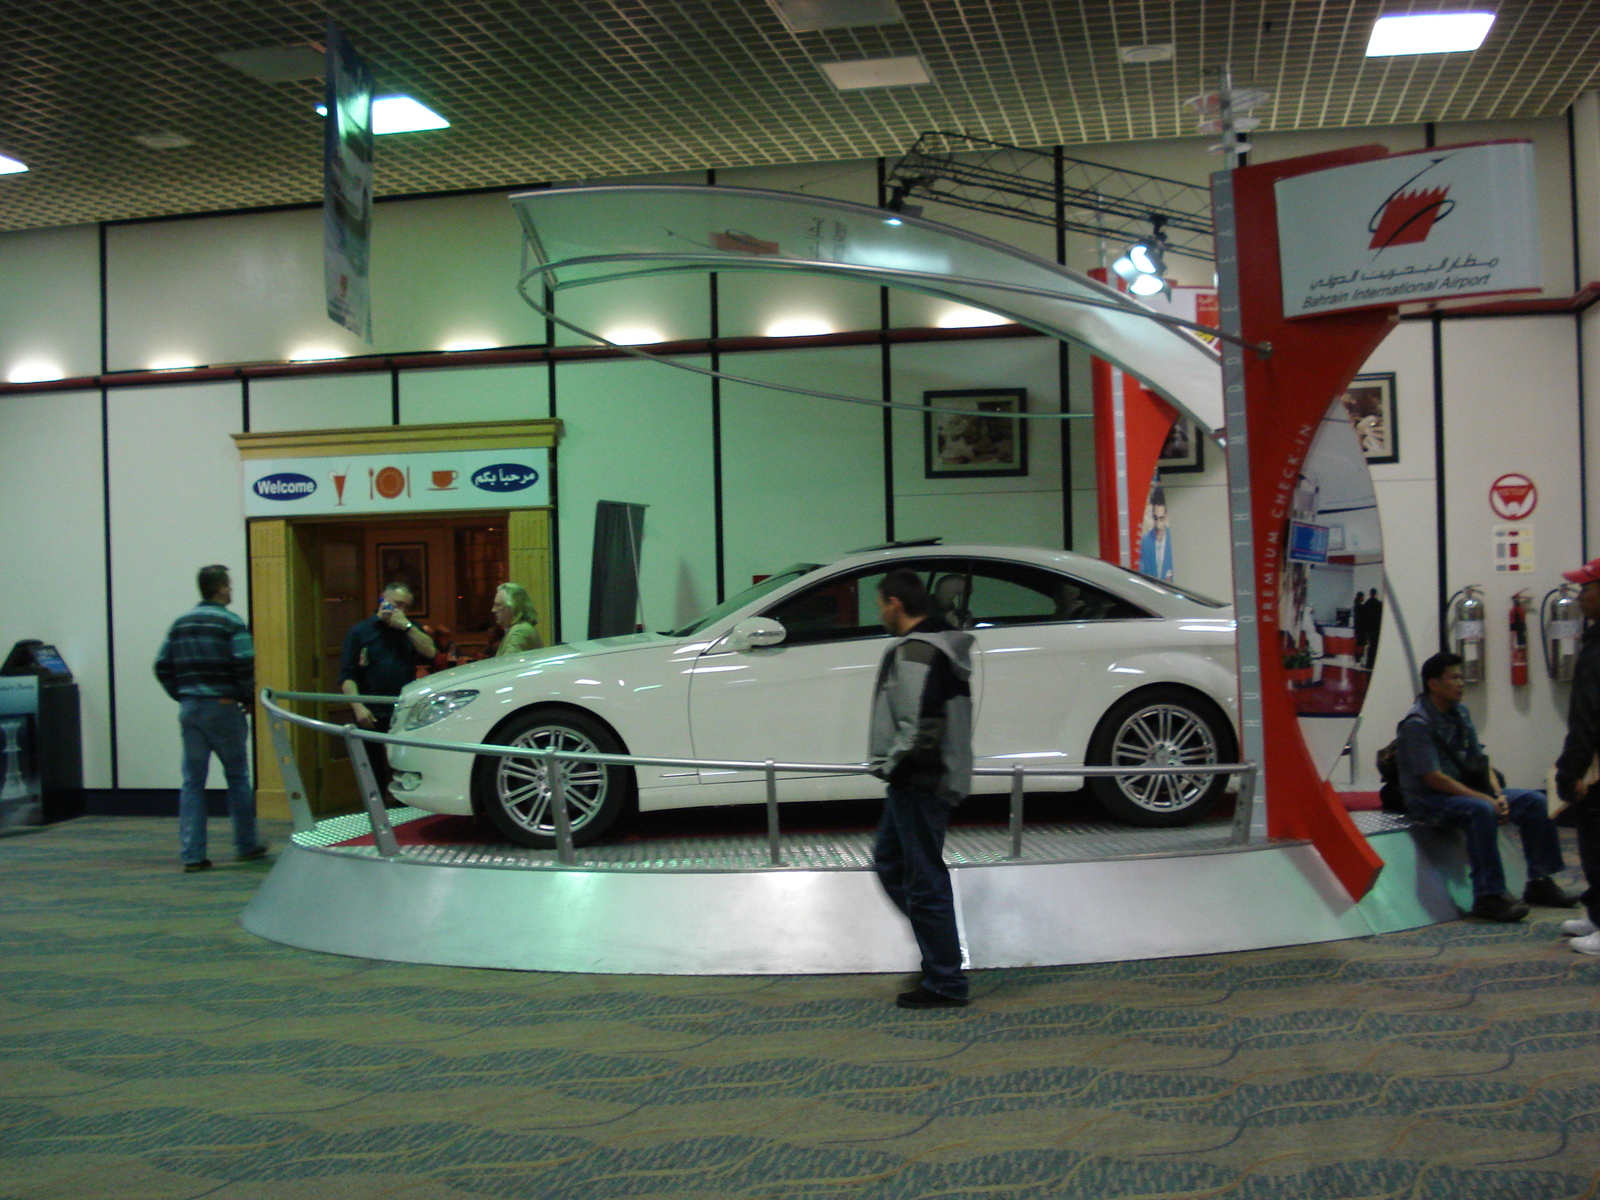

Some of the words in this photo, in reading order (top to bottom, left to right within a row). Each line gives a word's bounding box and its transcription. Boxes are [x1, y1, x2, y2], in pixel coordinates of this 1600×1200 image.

[1302, 291, 1349, 309] Bahrain
[1352, 279, 1438, 302] International
[1439, 272, 1492, 290] Airport
[257, 479, 314, 495] Welcome
[1231, 486, 1250, 547] THE
[1263, 531, 1279, 622] PREMIUM
[1237, 589, 1255, 623] OF
[1242, 664, 1260, 728] HUB
